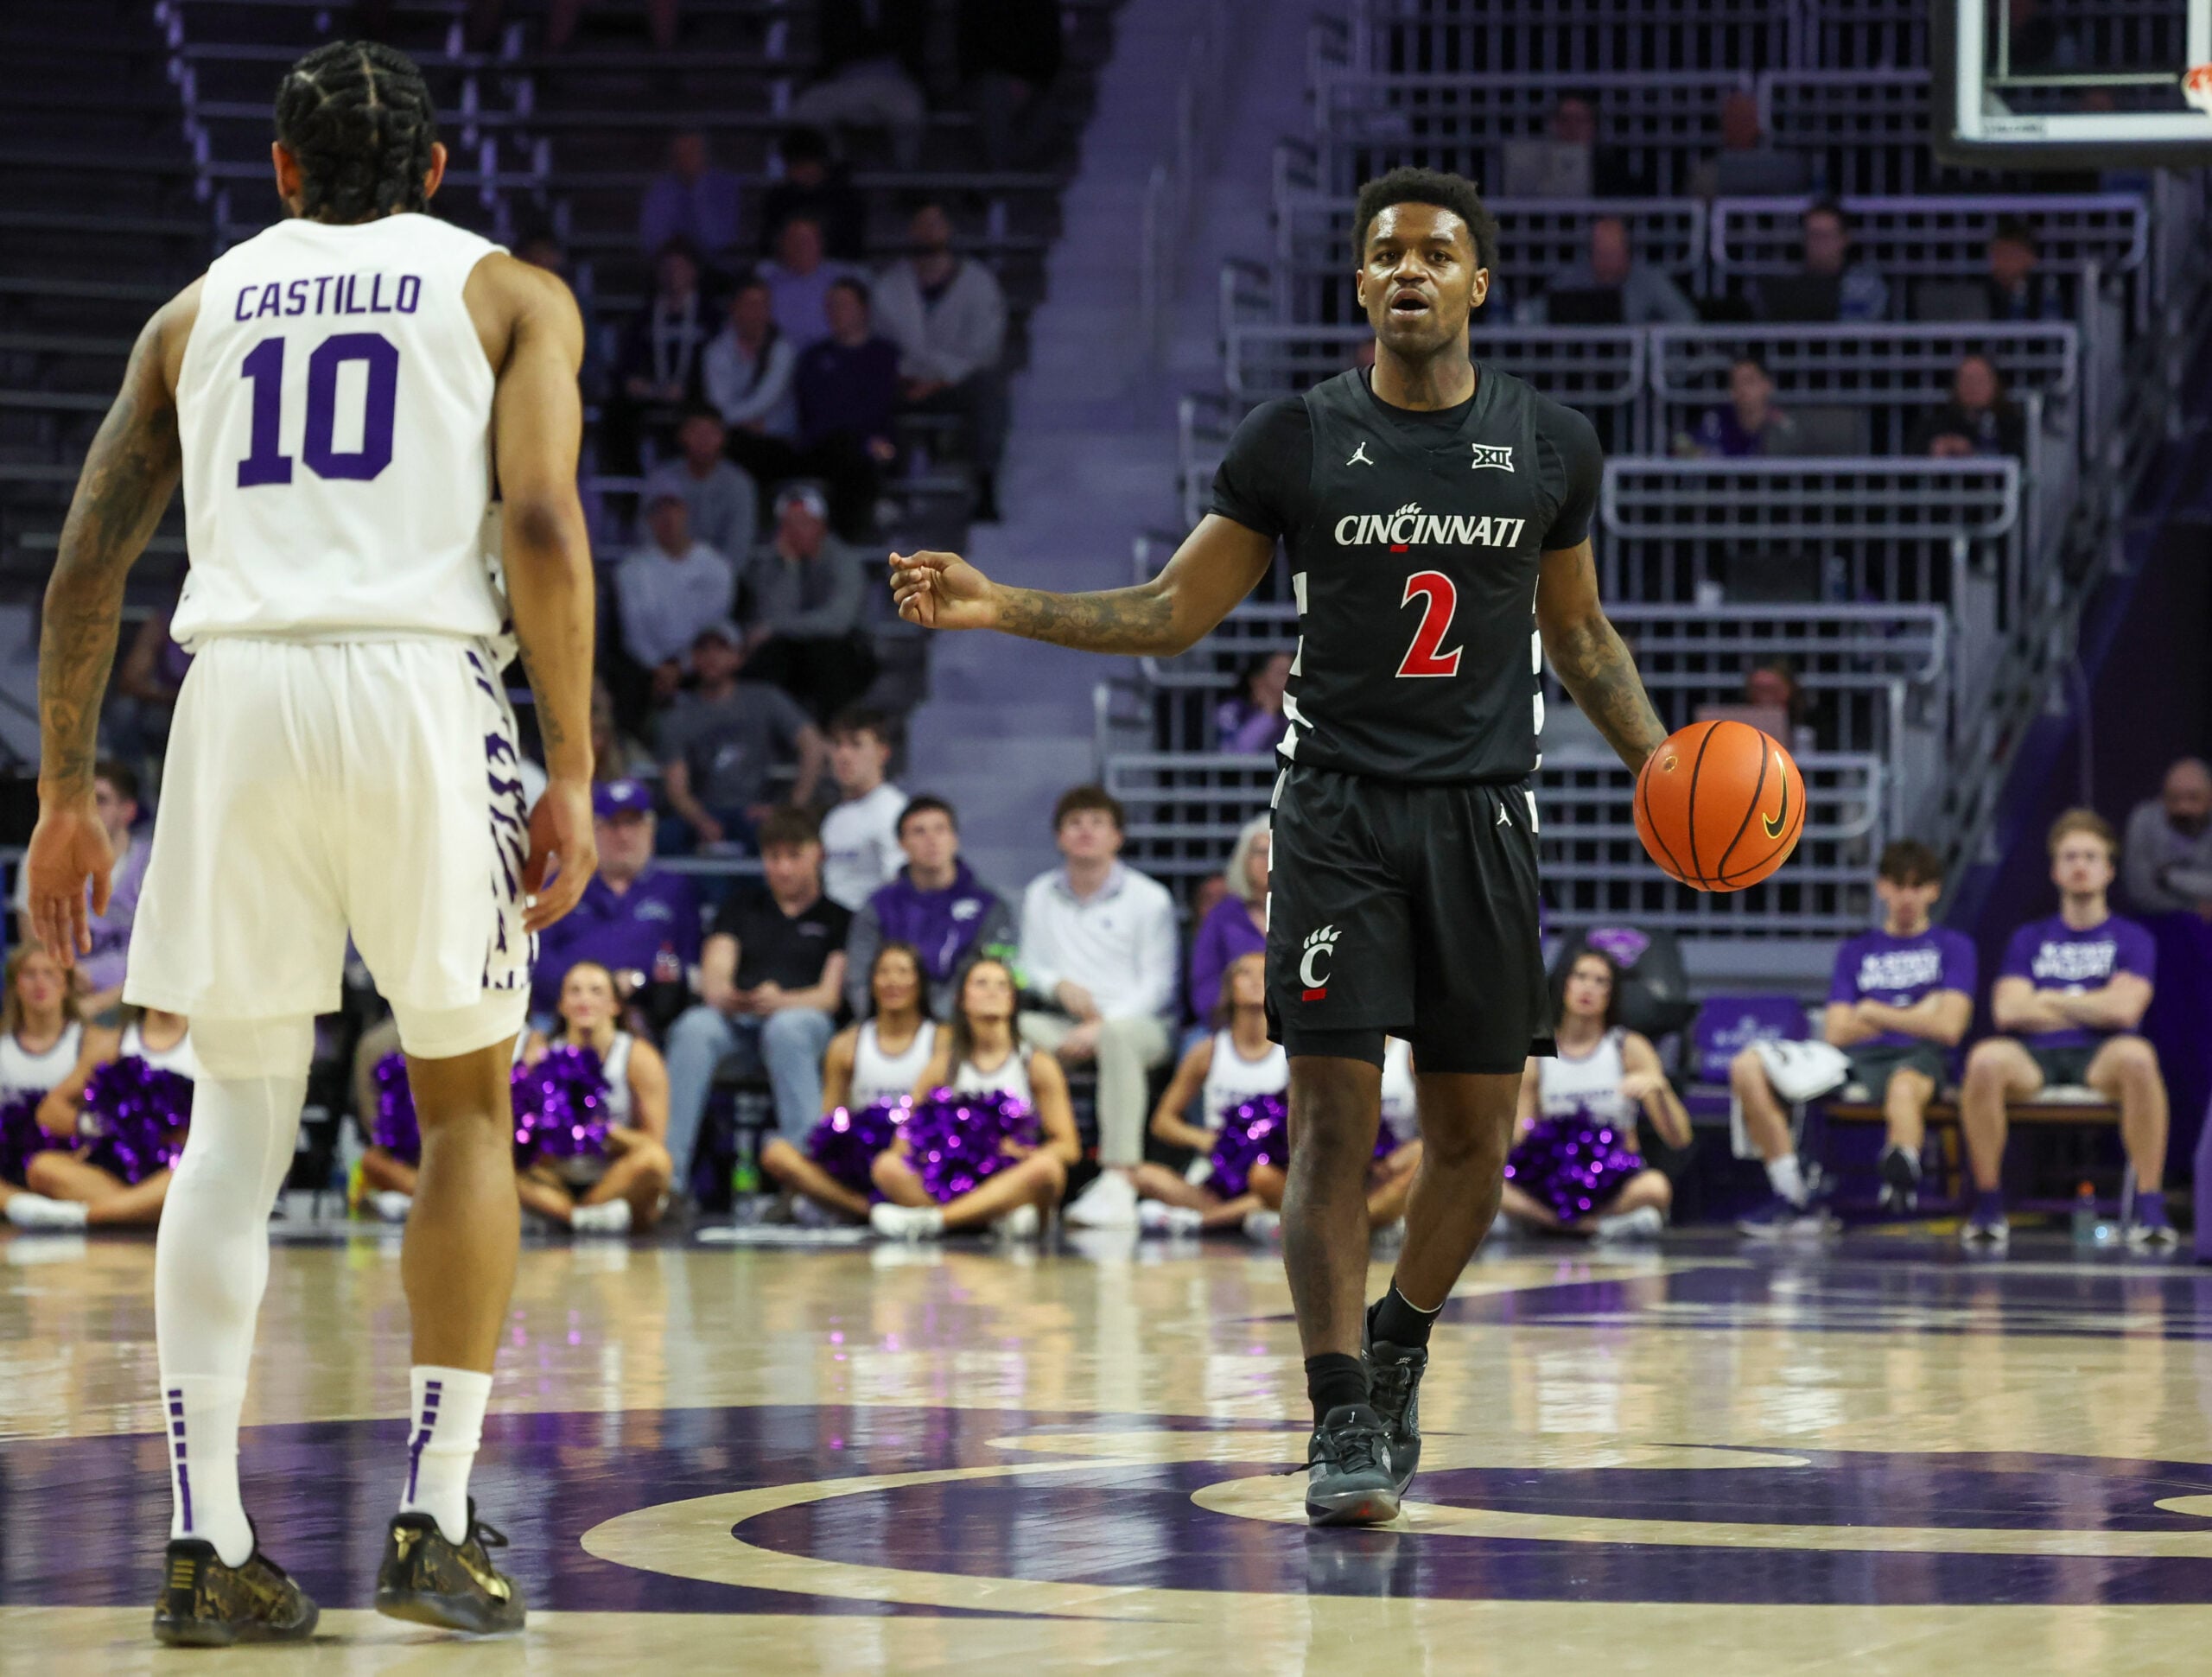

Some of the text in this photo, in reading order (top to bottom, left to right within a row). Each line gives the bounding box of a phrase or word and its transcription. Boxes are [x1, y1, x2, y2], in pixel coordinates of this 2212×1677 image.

[234, 273, 422, 322] CASTILLO
[237, 332, 399, 488] 10
[1334, 514, 1526, 548] CINCINNATI
[1395, 570, 1464, 677] 2
